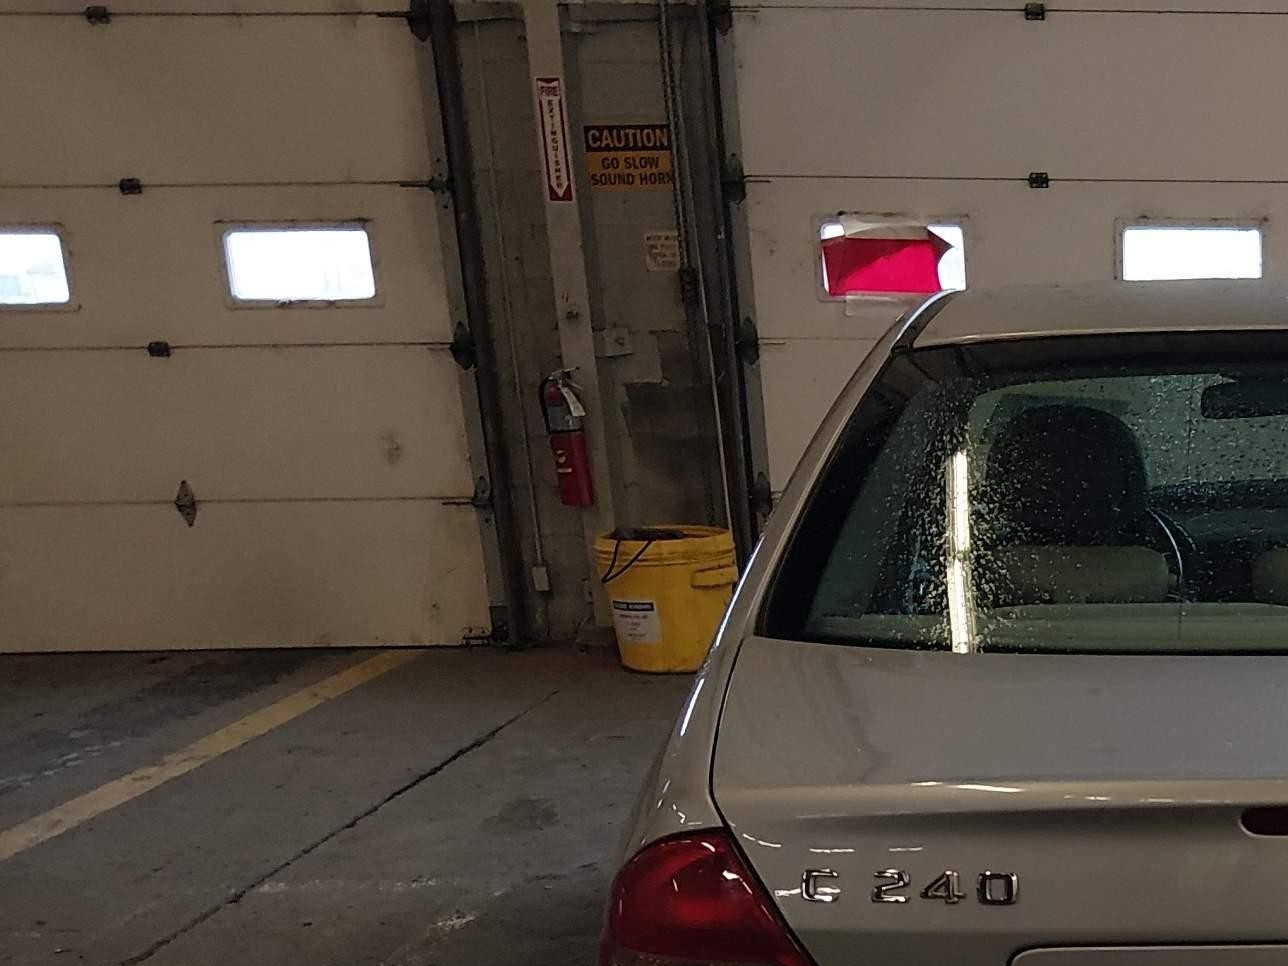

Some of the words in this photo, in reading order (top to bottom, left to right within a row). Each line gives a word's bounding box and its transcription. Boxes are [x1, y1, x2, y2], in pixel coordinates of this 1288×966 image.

[587, 128, 669, 149] CAUTION
[602, 157, 620, 169] GO
[624, 156, 659, 169] SLOW
[592, 173, 635, 186] SOUND
[801, 868, 841, 903] C
[871, 868, 1019, 906] 240
